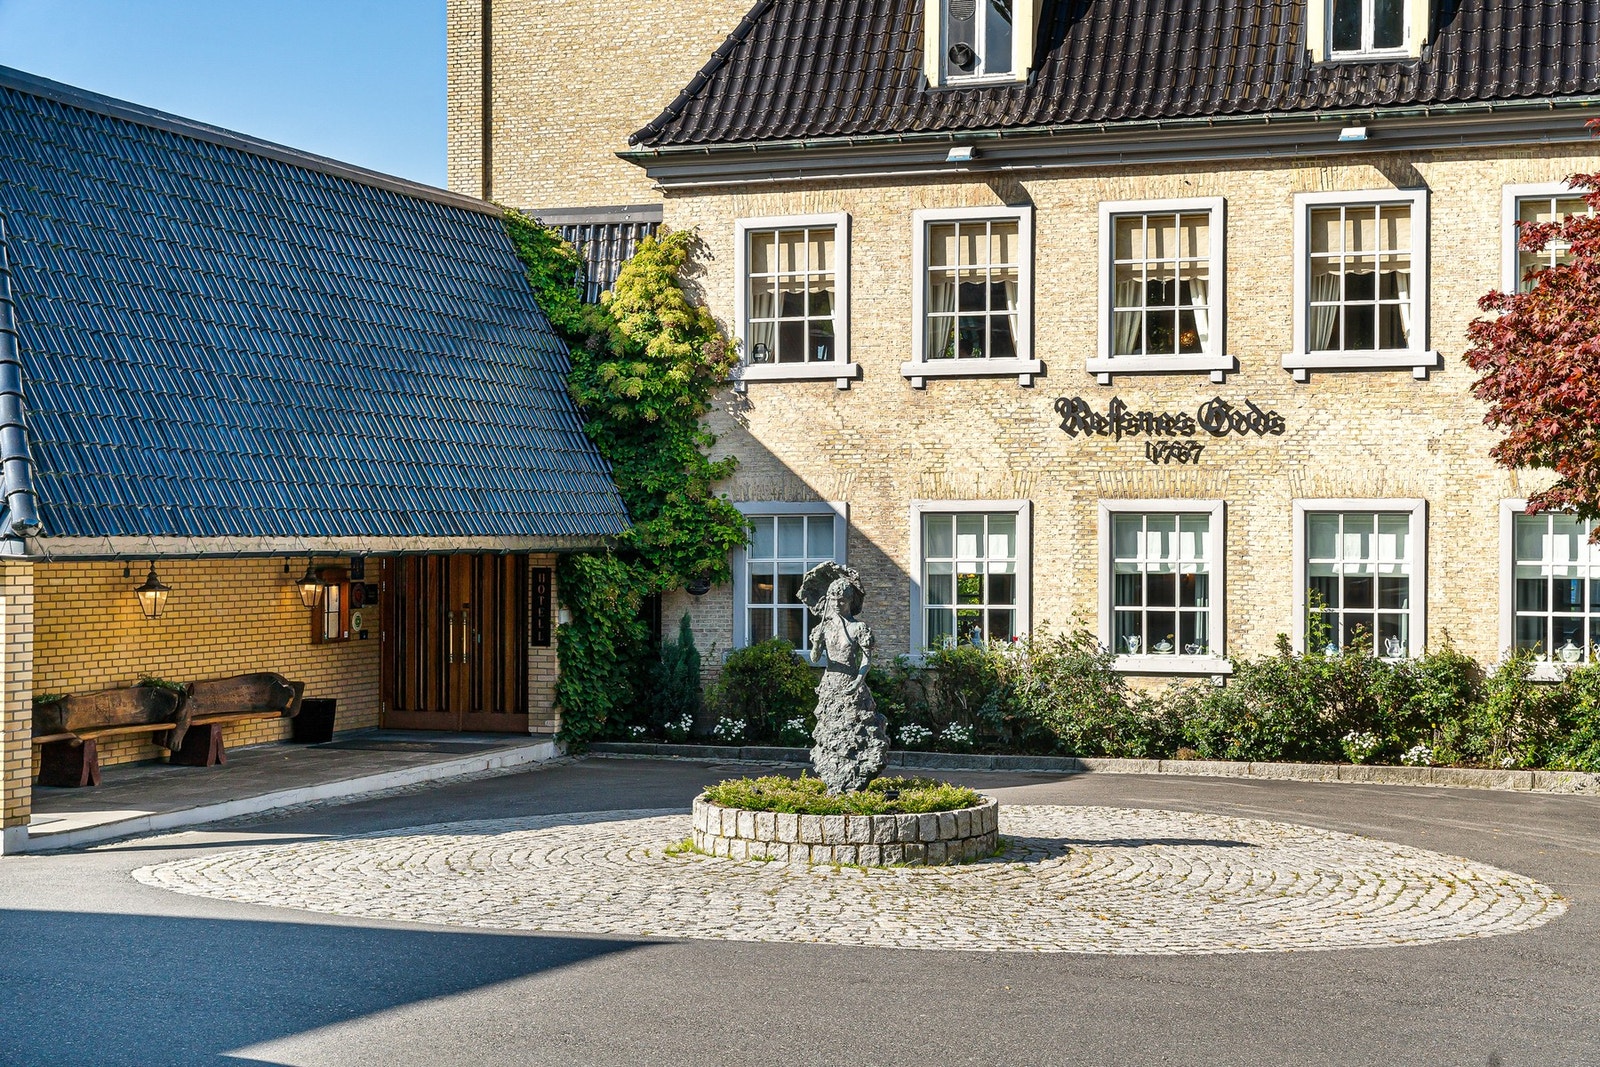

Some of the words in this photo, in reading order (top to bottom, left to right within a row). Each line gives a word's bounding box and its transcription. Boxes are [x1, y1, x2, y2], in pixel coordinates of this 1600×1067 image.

[1054, 396, 1196, 442] Refsnes
[1197, 396, 1286, 437] Gods
[537, 572, 546, 641] HOTELL
